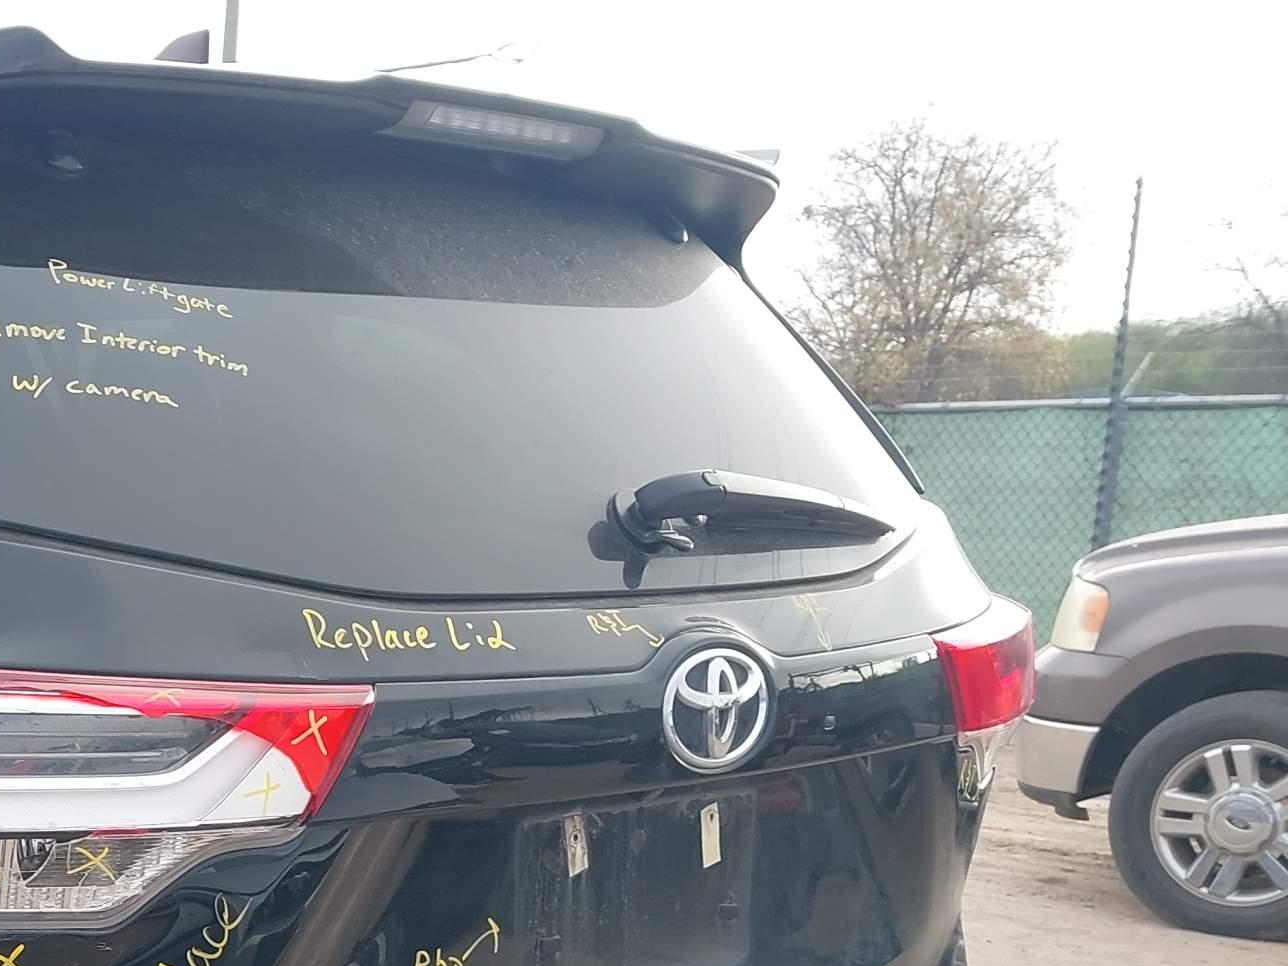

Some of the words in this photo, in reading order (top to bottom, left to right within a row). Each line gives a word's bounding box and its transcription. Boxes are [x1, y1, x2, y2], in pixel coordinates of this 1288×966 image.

[47, 258, 116, 290] Power
[76, 321, 187, 357] Interior
[194, 344, 249, 377] trim
[66, 379, 180, 408] camera
[302, 607, 437, 662] Replace
[445, 616, 516, 651] Lid
